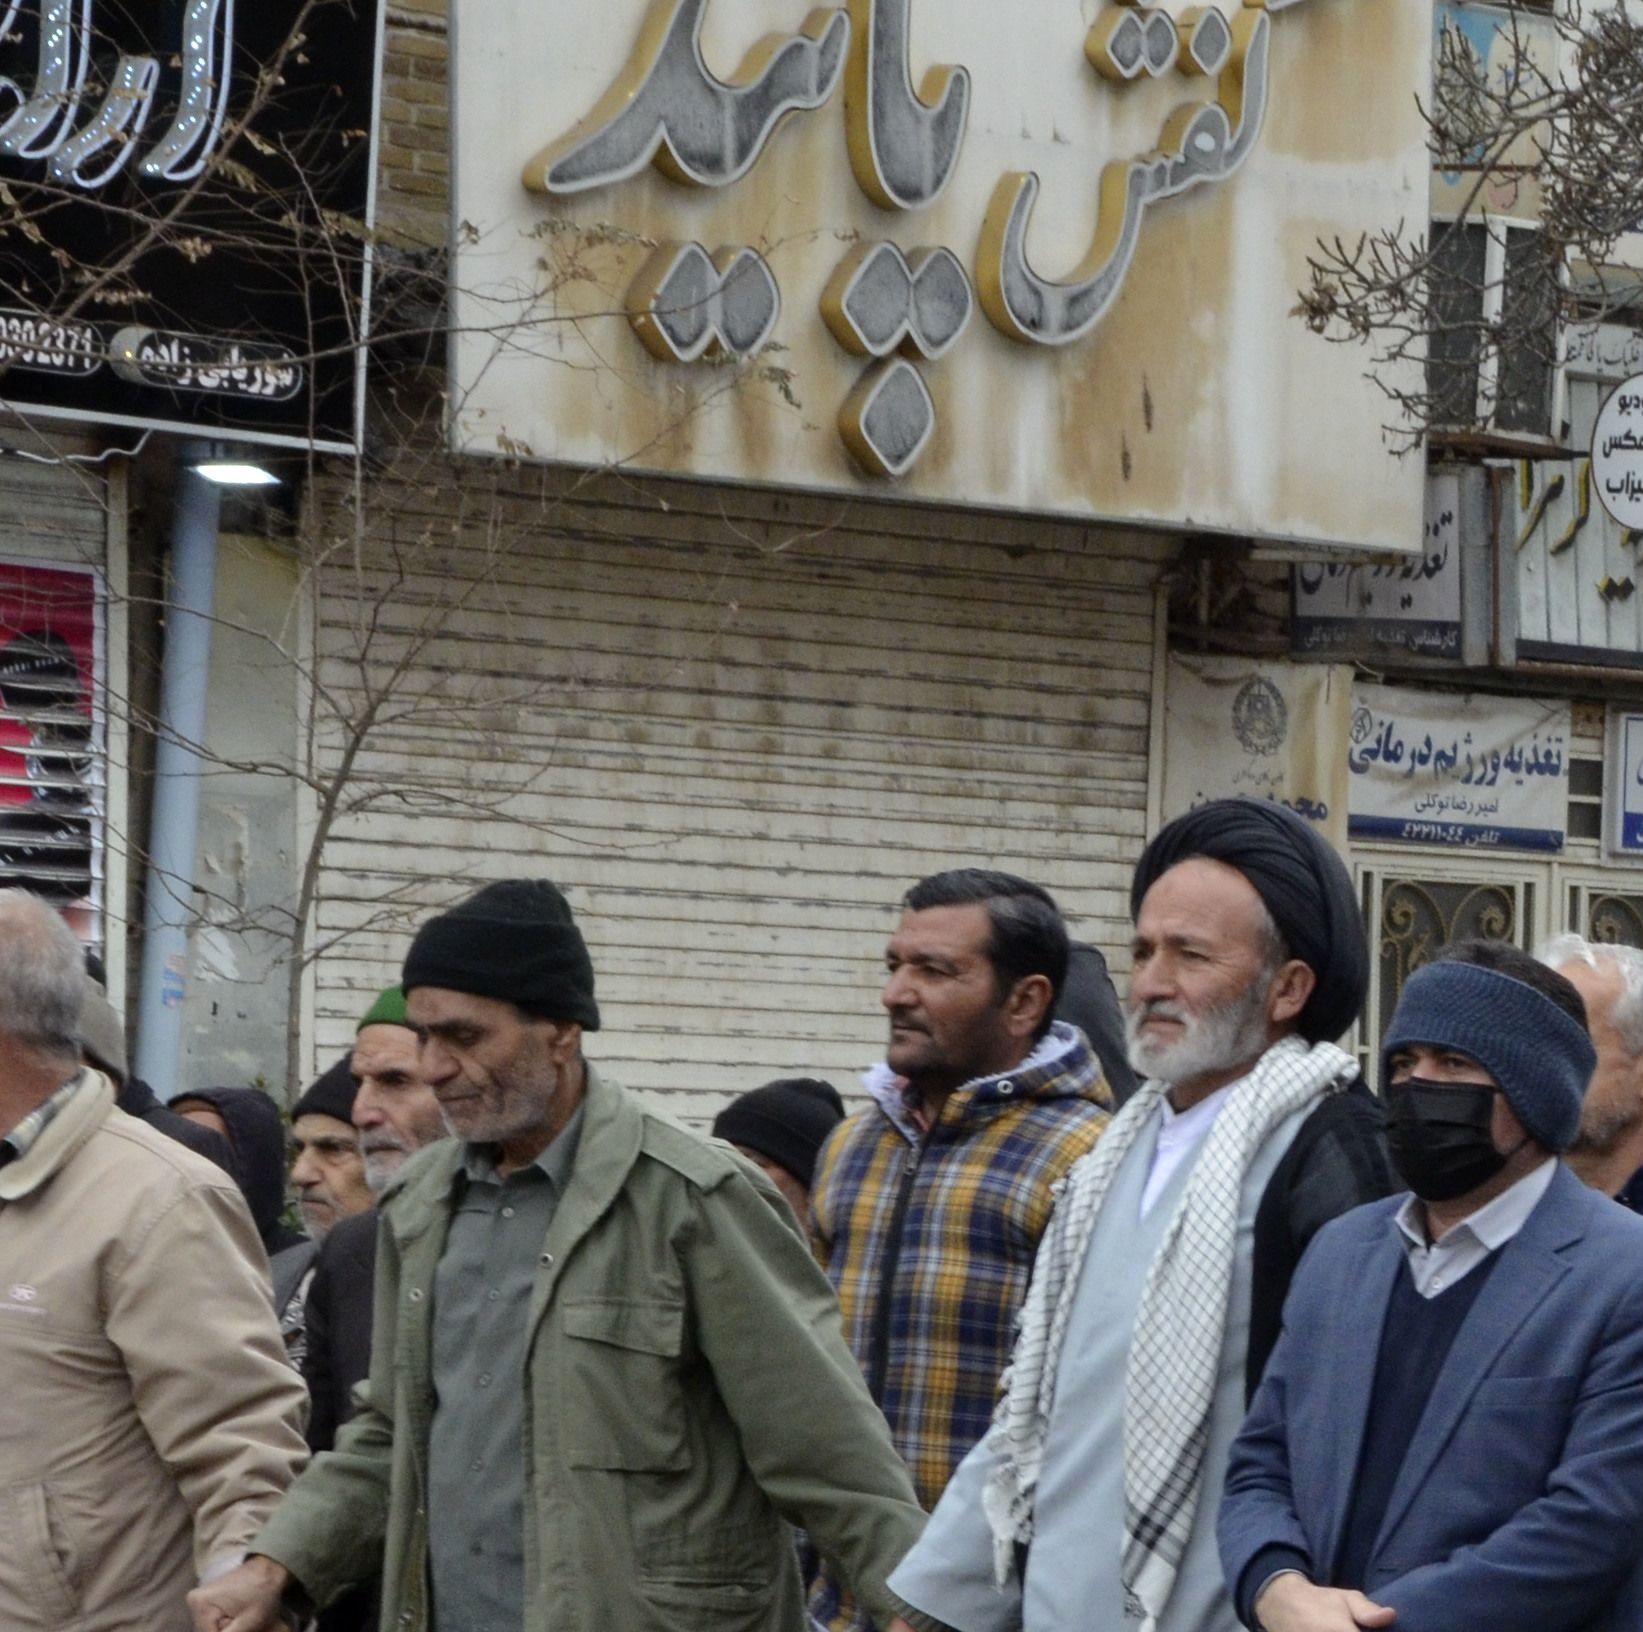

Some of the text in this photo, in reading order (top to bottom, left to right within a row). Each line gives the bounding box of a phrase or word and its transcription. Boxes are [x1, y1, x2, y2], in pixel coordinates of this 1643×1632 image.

[1348, 719, 1433, 779] درمانی
[1503, 732, 1563, 785] تغذیه
[1414, 792, 1451, 814] توکلی
[1465, 830, 1500, 848] تلفن
